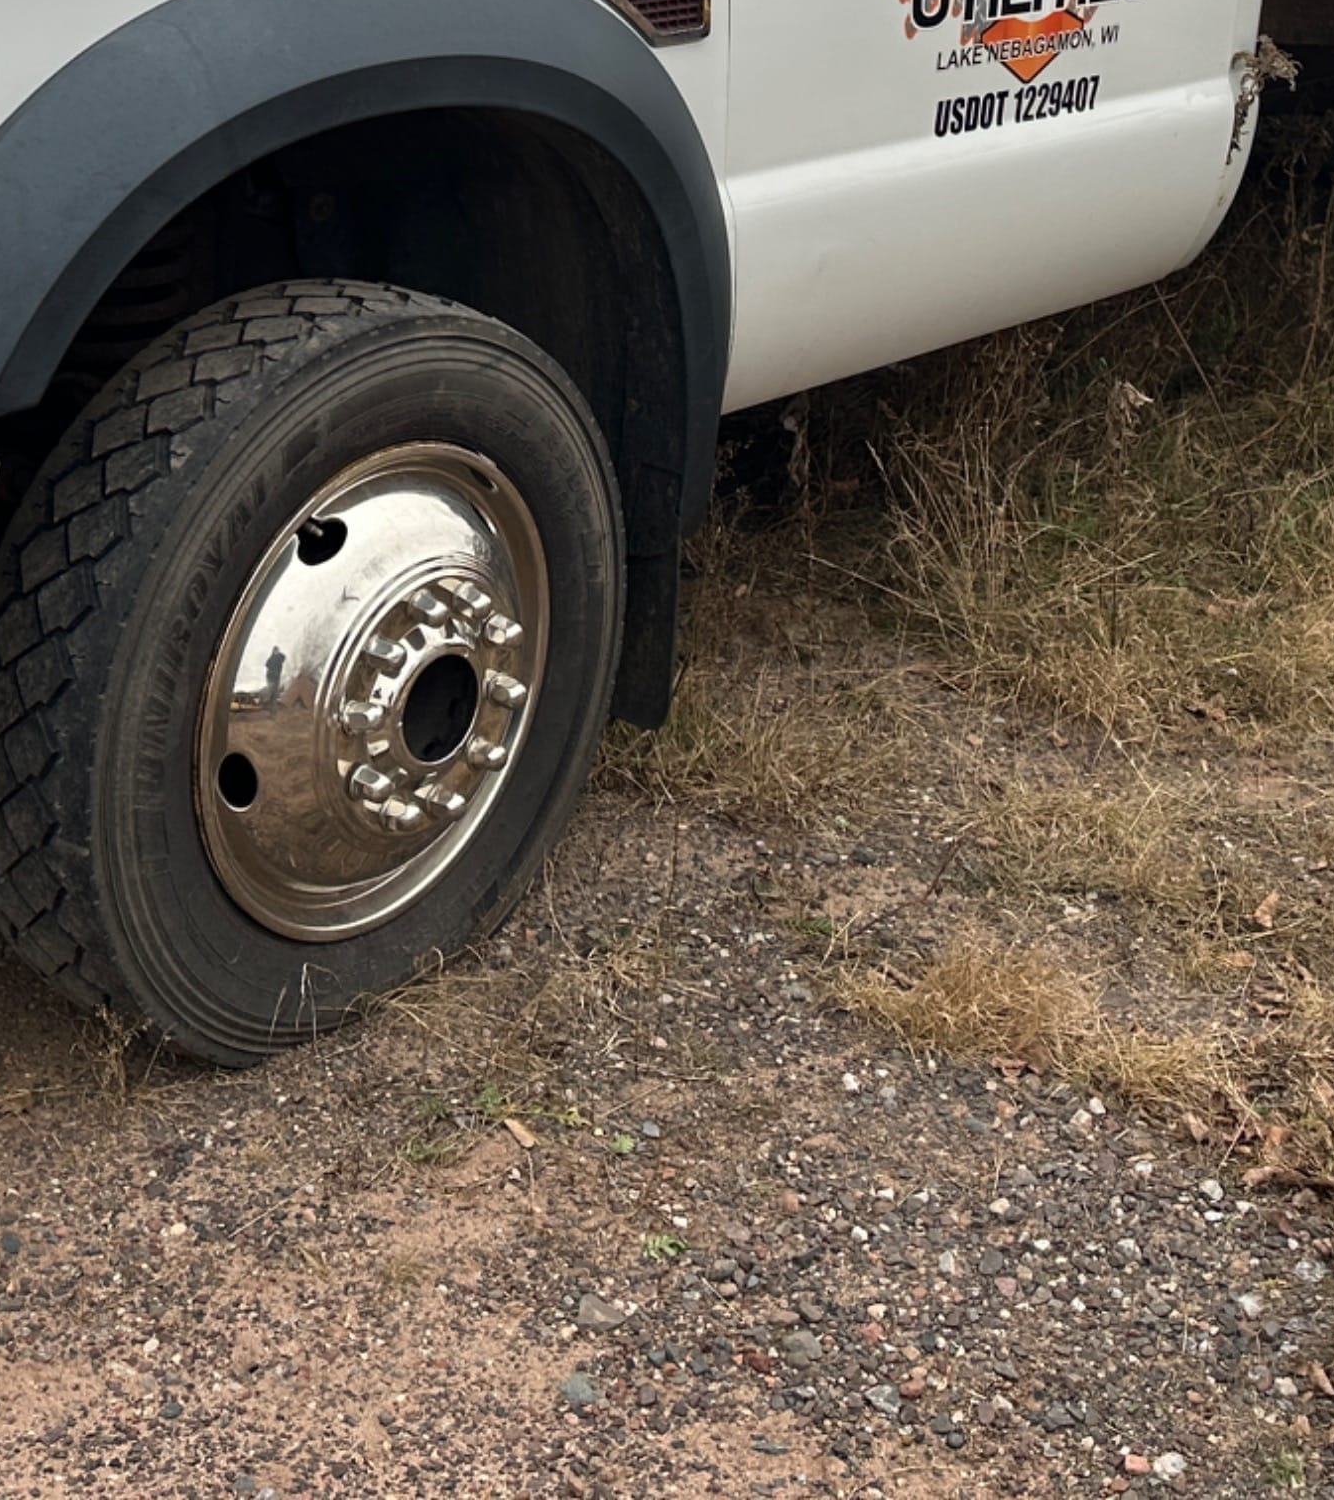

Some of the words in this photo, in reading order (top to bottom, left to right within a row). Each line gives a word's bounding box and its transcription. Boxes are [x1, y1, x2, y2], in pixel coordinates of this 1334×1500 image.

[936, 45, 983, 71] LAKE
[986, 29, 1095, 63] NEBAGAMON,
[1100, 25, 1121, 45] WI
[934, 91, 1009, 138] USDOT
[1014, 75, 1101, 123] 1229407
